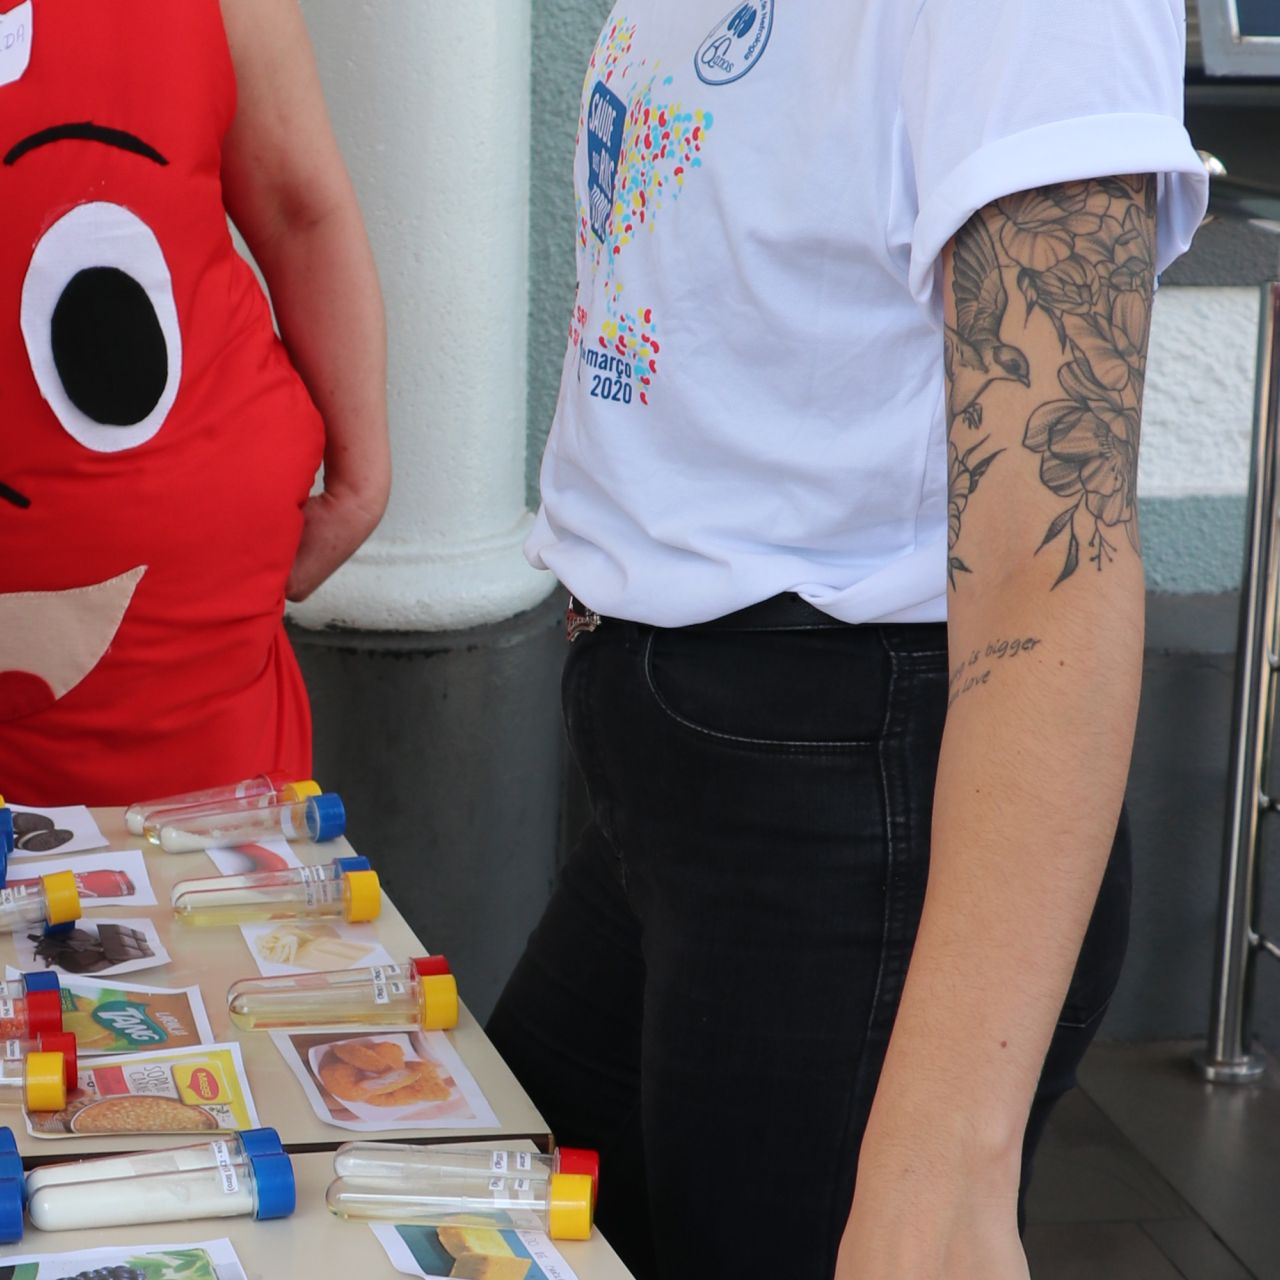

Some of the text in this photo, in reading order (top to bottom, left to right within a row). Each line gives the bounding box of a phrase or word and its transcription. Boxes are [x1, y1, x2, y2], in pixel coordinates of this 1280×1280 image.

[586, 348, 632, 379] março
[590, 375, 632, 405] 2020
[97, 1007, 160, 1041] TANG
